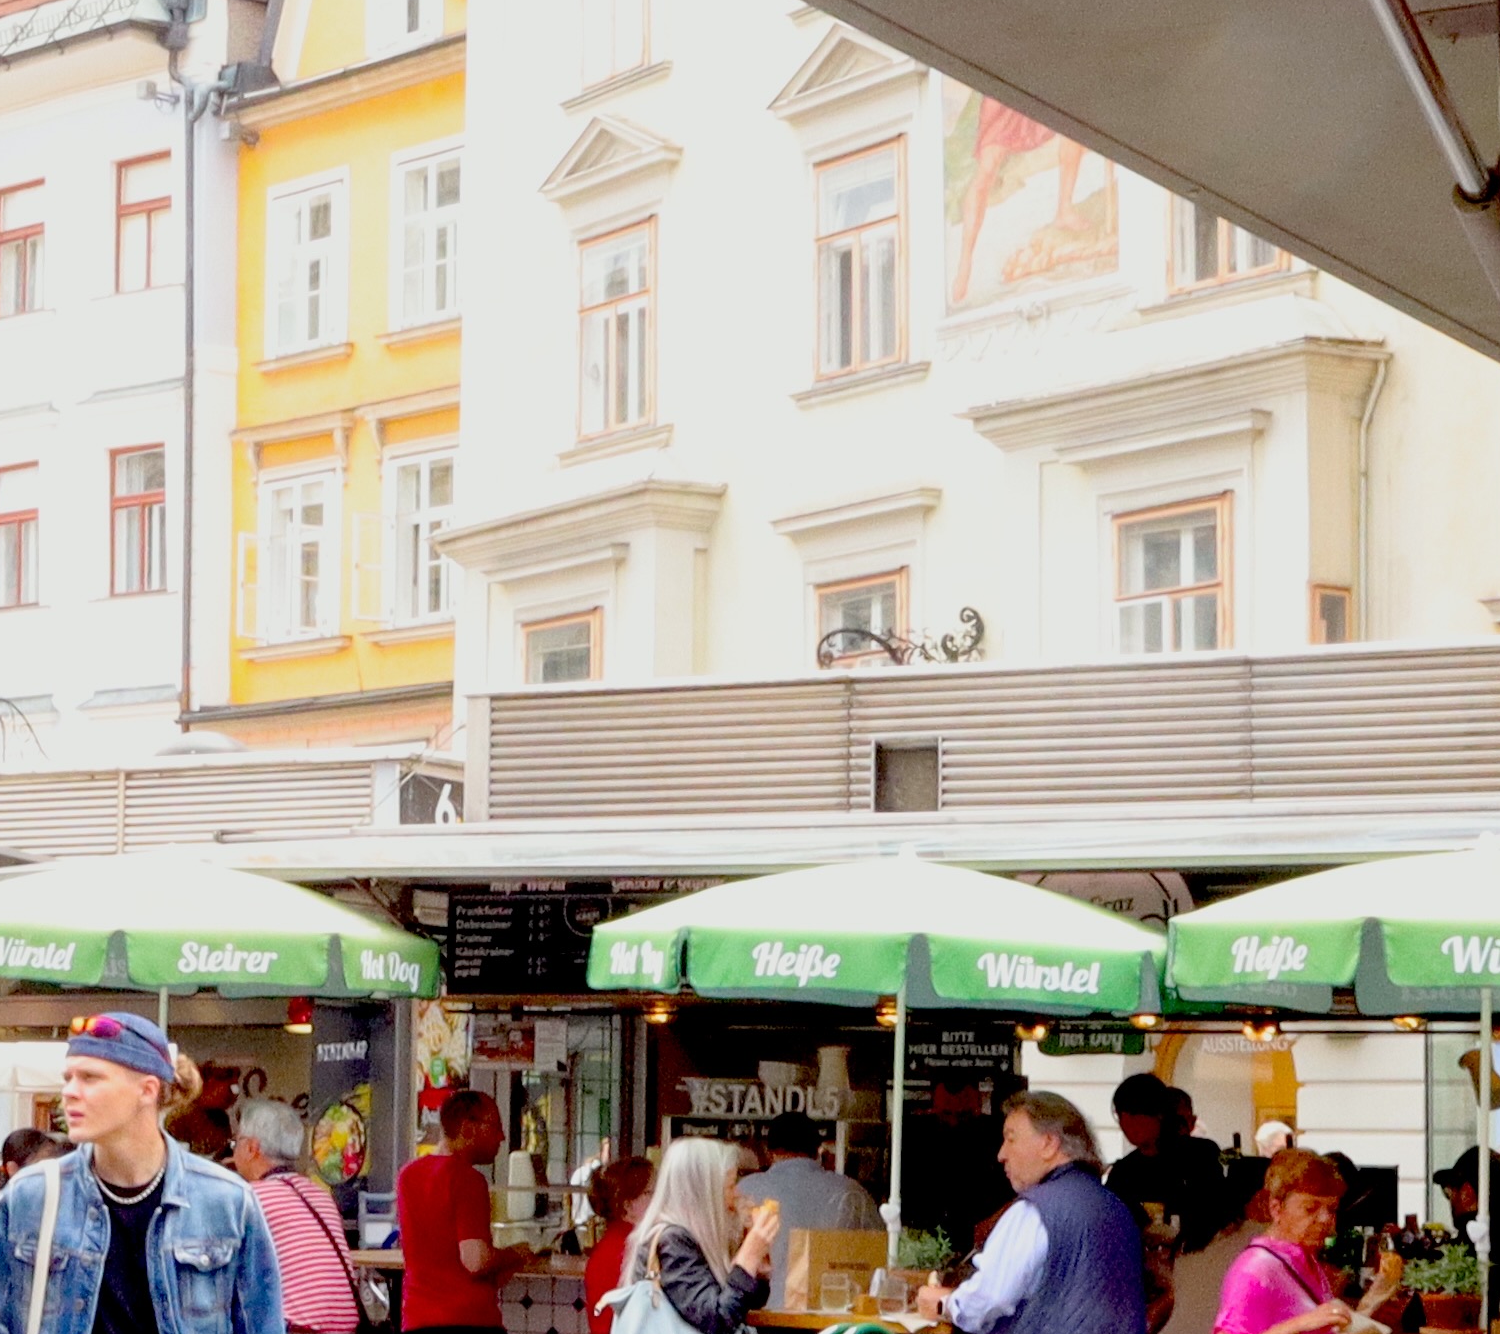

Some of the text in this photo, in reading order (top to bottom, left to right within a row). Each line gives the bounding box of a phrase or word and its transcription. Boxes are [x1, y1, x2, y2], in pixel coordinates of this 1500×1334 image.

[434, 782, 457, 825] 6
[177, 940, 279, 974] Steirer
[359, 949, 385, 981] Hot
[387, 951, 420, 993] Dog
[751, 941, 842, 988] Heiße
[976, 952, 1101, 994] Würstel
[1230, 935, 1309, 981] Heiße
